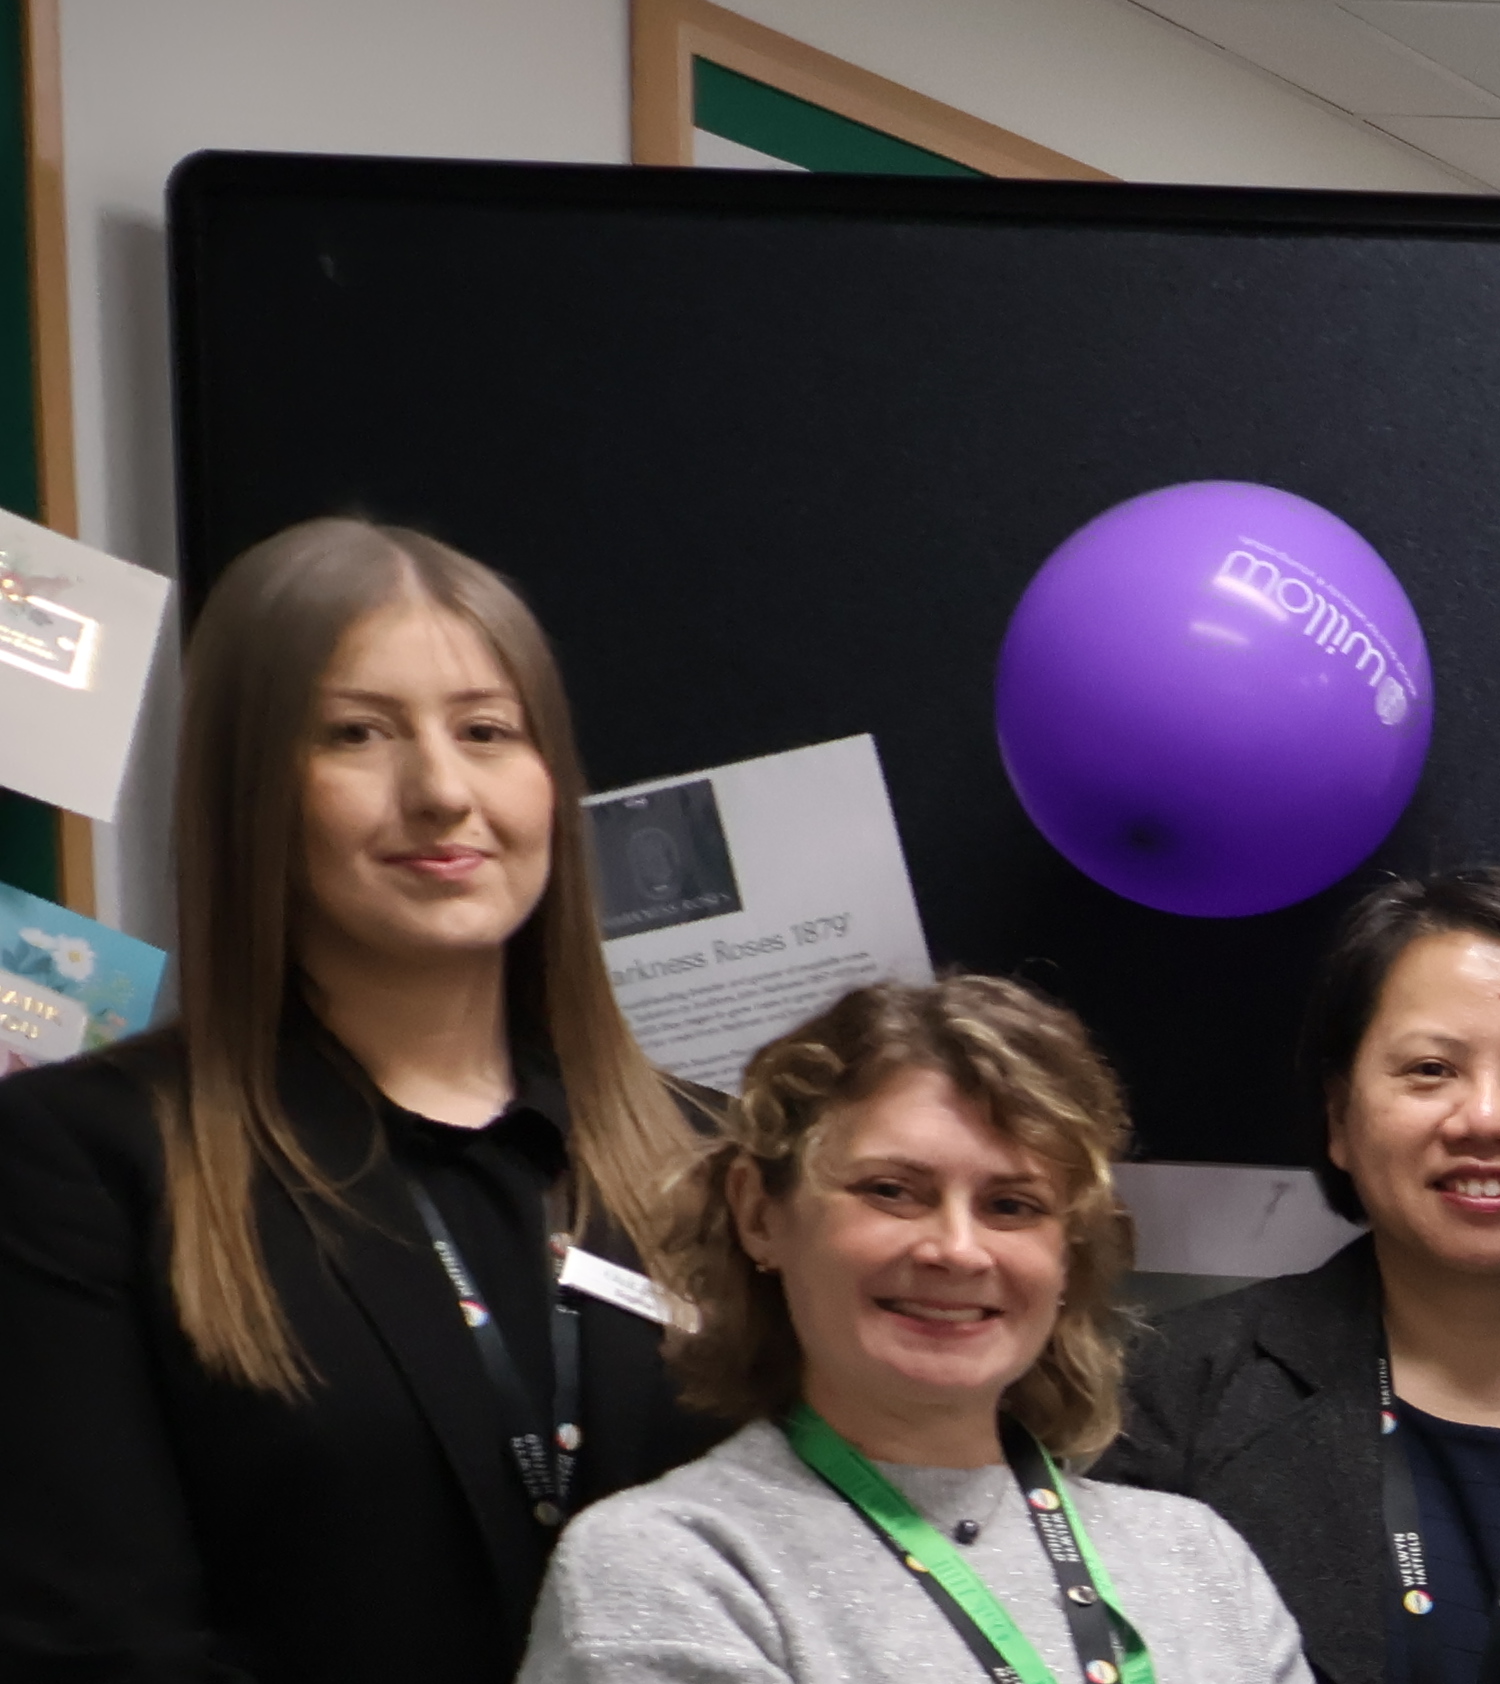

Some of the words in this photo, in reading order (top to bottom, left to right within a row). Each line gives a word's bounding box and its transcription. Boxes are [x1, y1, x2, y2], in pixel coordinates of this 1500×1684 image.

[1217, 550, 1387, 687] willow
[712, 933, 787, 965] Roses
[1394, 1533, 1414, 1586] WELWYN
[1408, 1532, 1427, 1585] HATFIELD
